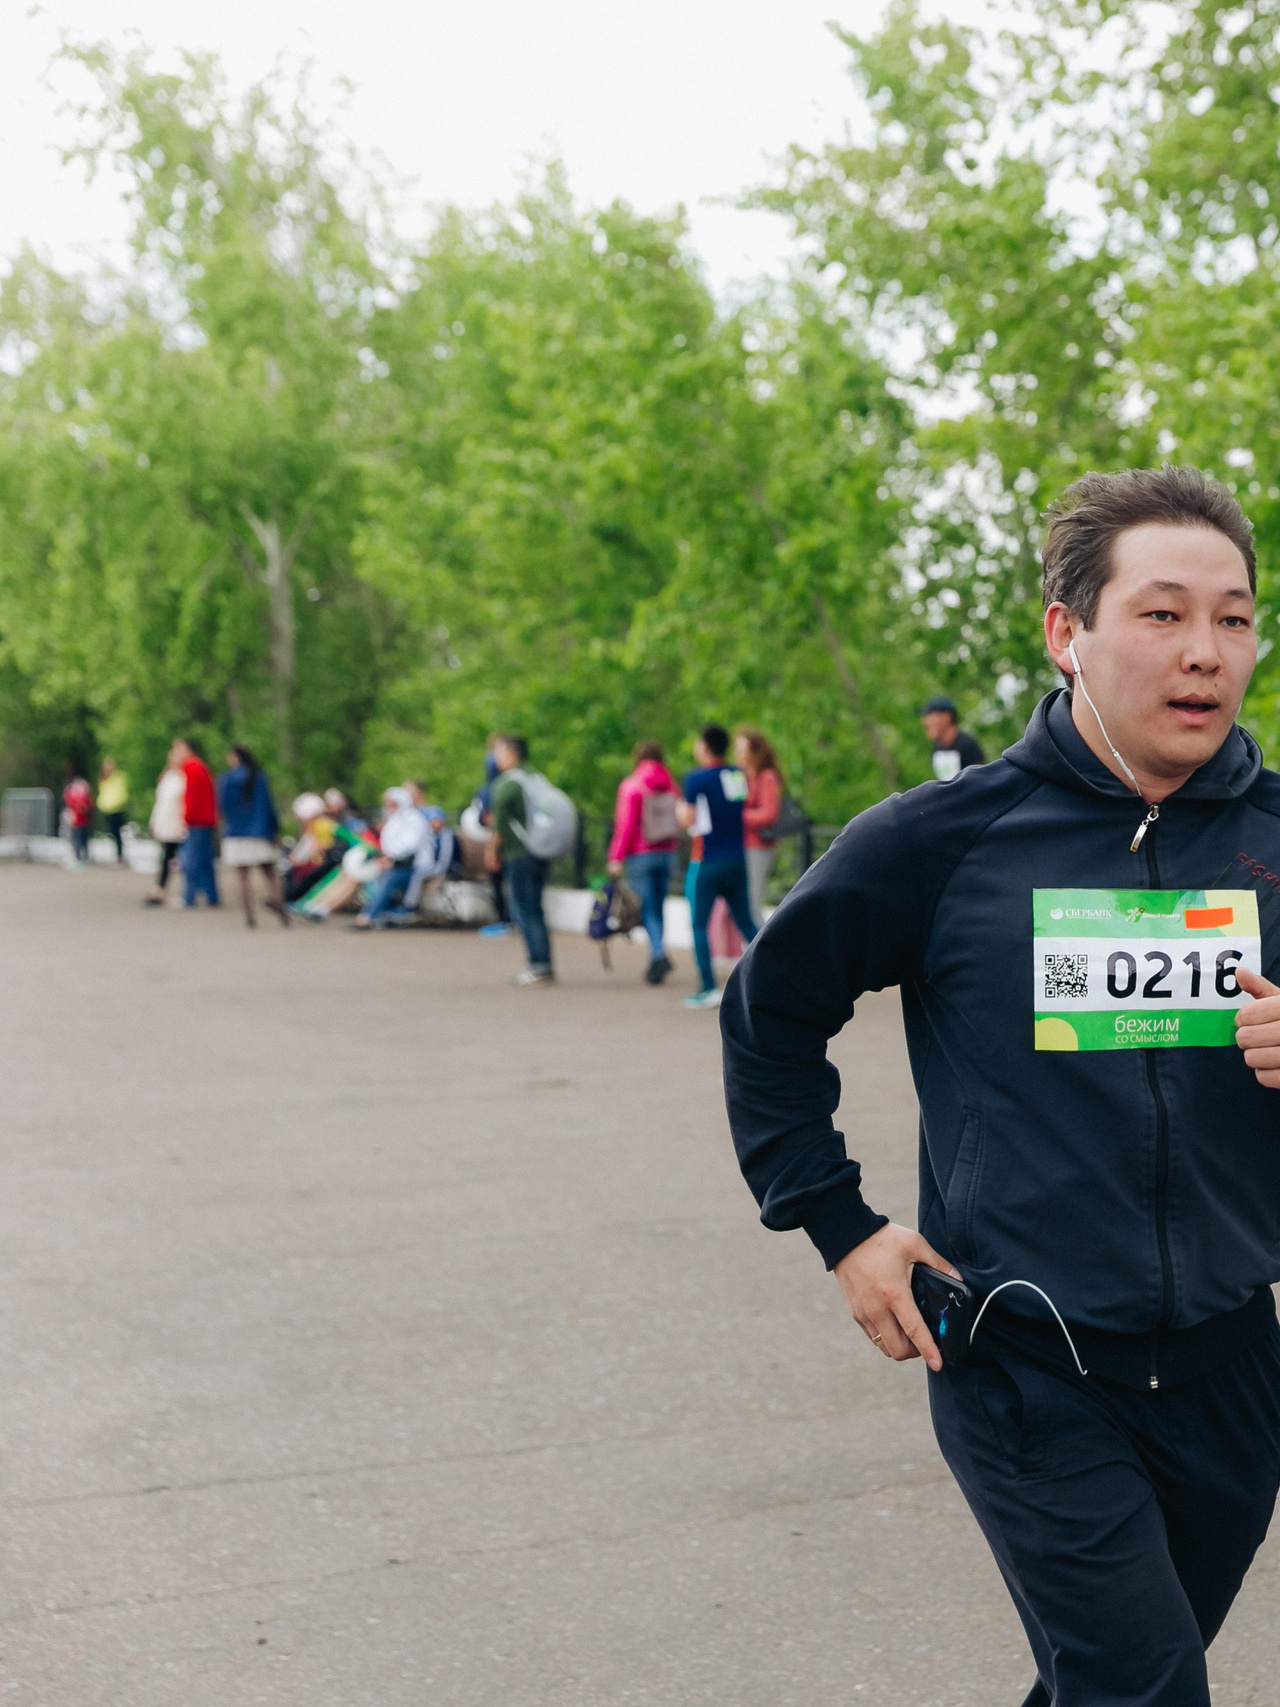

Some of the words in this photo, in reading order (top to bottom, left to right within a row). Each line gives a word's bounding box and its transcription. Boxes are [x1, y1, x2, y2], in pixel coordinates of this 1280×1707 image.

[1065, 908, 1112, 918] СБЕРБАНК
[1107, 949, 1243, 998] 0216
[1114, 1015, 1180, 1033] бежим
